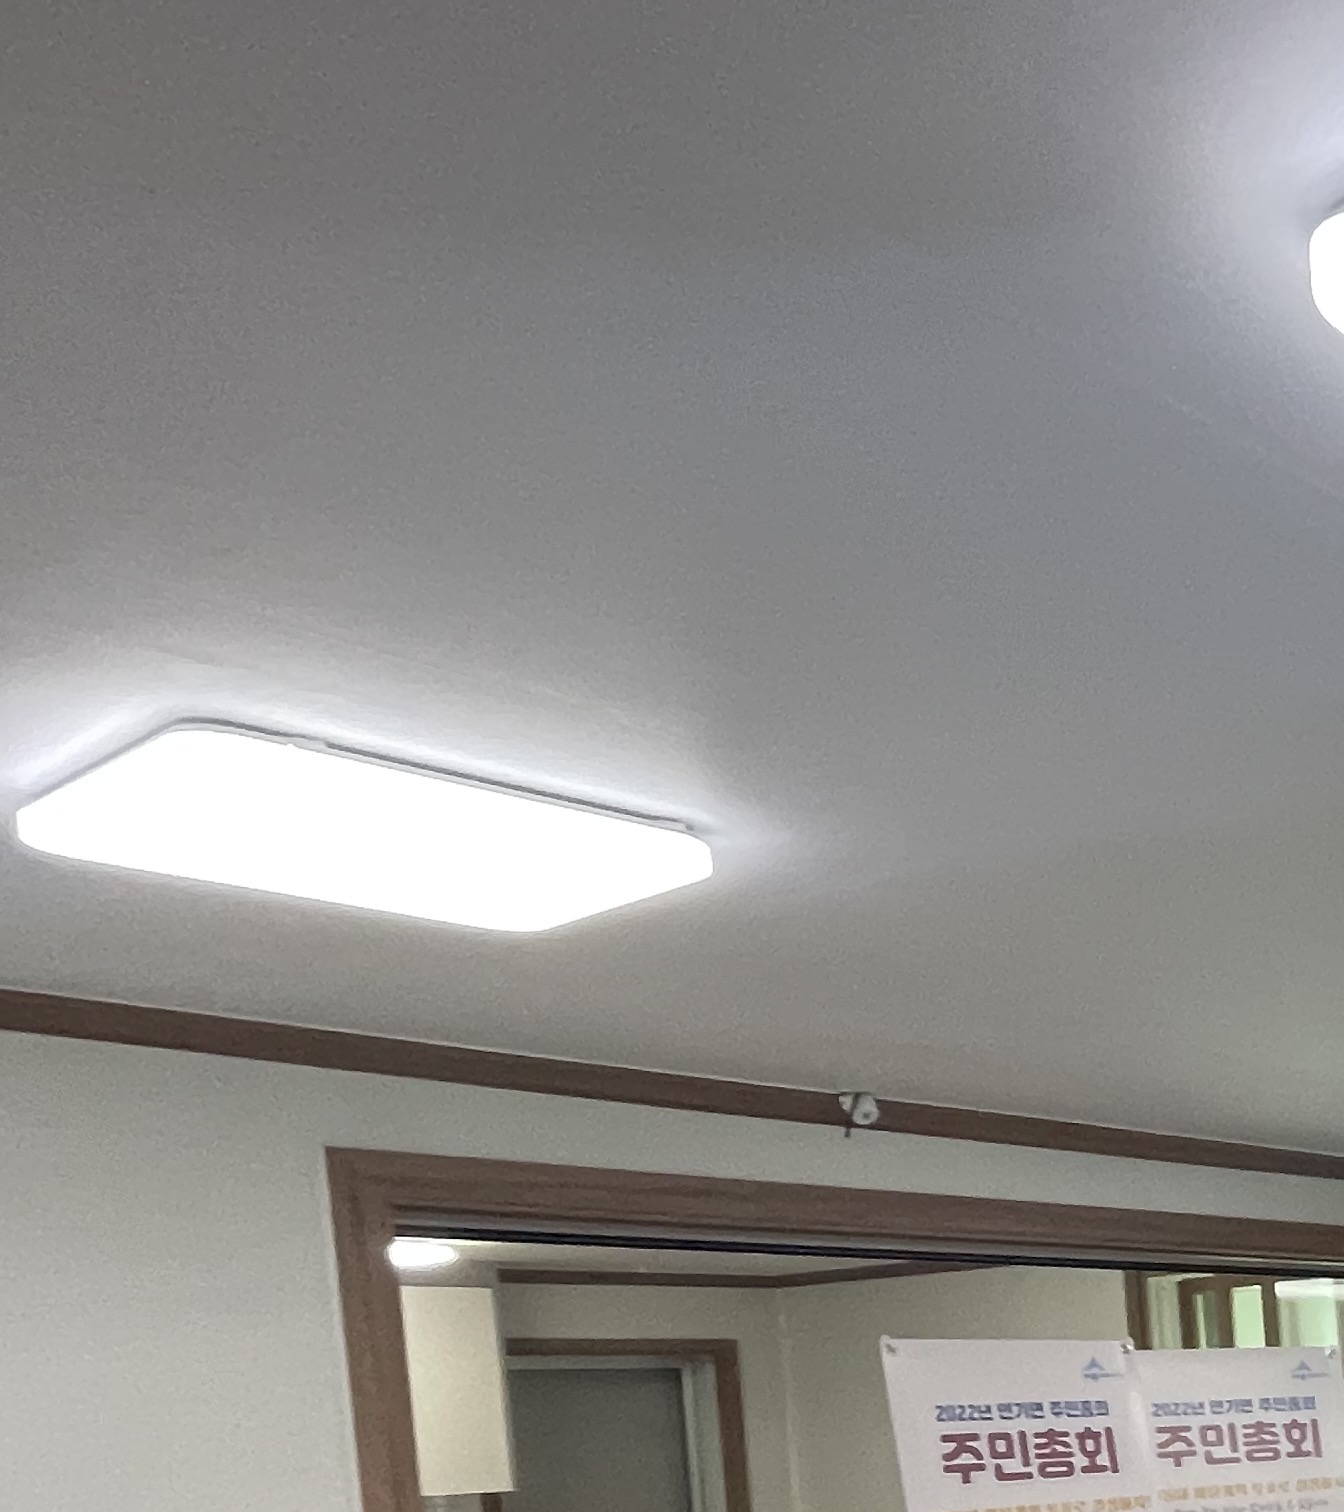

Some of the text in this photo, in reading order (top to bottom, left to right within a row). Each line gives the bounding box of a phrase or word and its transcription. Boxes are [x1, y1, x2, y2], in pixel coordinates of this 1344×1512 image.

[935, 1403, 994, 1422] 2022년
[939, 1426, 1120, 1485] 주민총회
[1155, 1418, 1323, 1468] 주민총회
